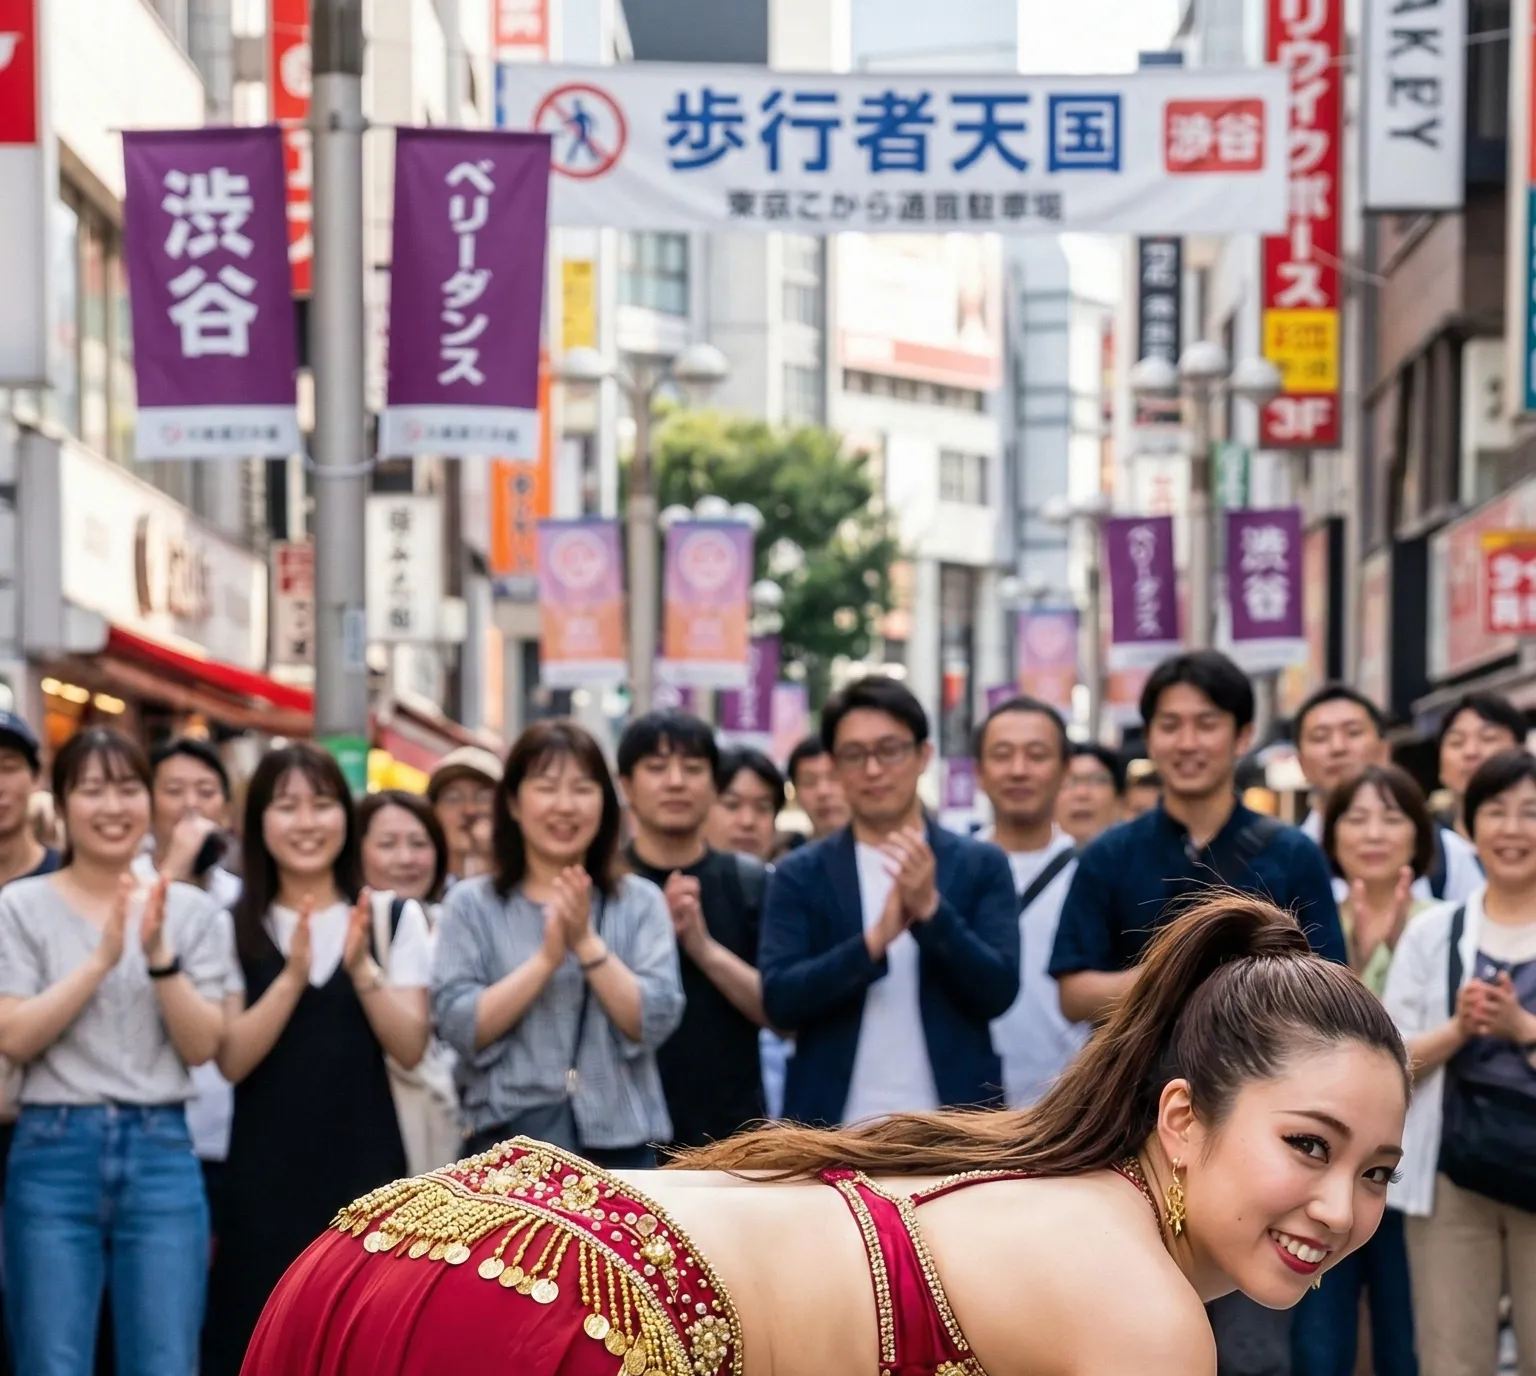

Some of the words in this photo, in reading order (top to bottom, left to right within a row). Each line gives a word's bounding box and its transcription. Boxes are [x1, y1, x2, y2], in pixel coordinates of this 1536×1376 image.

[665, 89, 1123, 173] 歩行者天国
[1168, 113, 1262, 163] 渋谷
[161, 166, 258, 358] 渋谷
[437, 158, 496, 387] ベリーダンス
[1267, 398, 1330, 439] 3F
